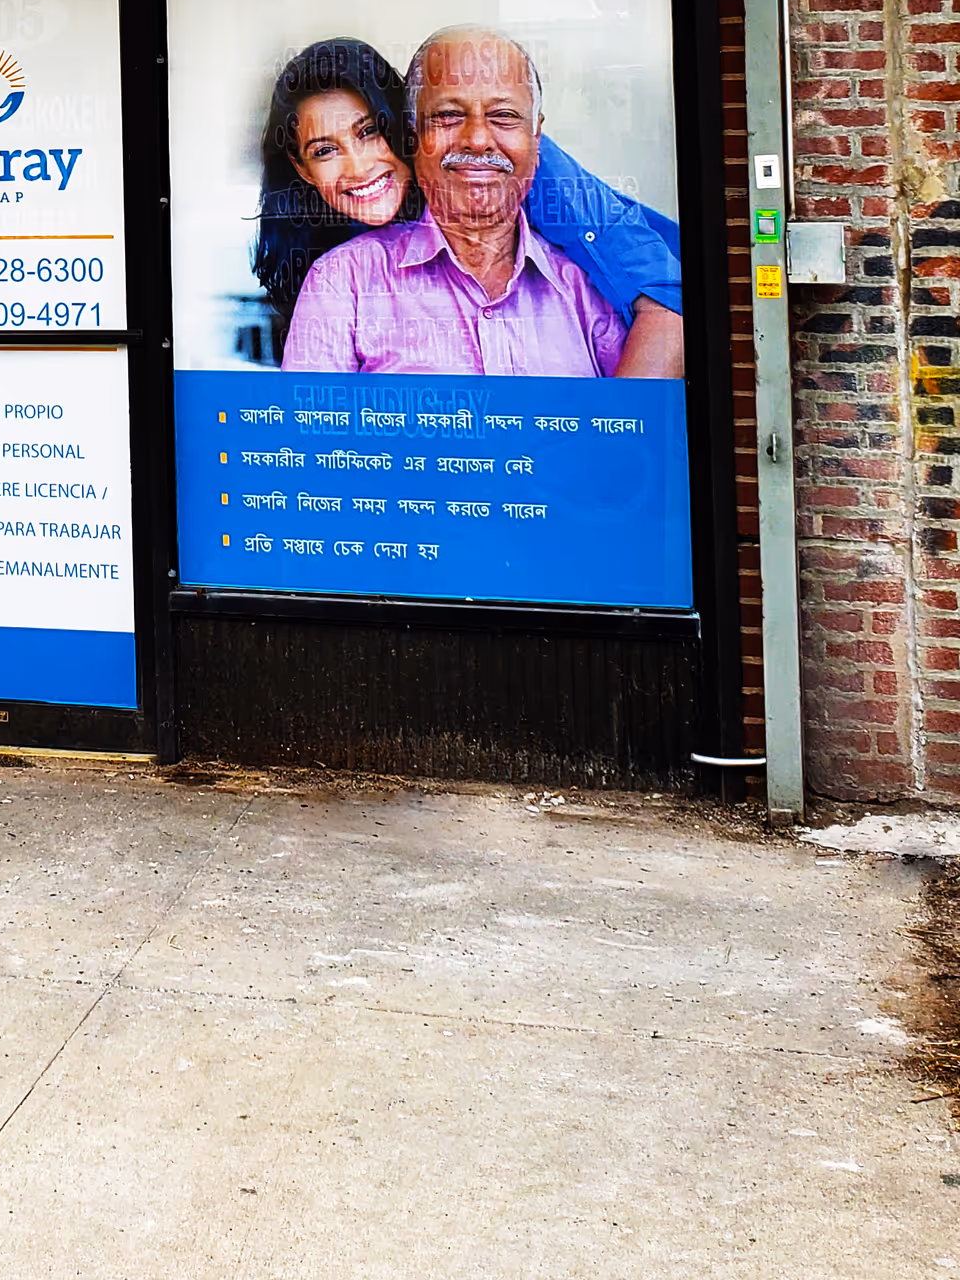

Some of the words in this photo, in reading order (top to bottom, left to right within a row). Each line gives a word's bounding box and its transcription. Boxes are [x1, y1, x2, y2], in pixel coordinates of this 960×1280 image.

[5, 404, 63, 419] PROPIO
[240, 406, 284, 424] আপনি
[294, 410, 351, 426] আপনার
[361, 408, 407, 427] নিজের
[417, 409, 473, 430] সহকারী
[484, 415, 524, 430] পছন্দ
[534, 416, 580, 432] করতে
[3, 443, 84, 459] PERSONAL
[241, 448, 306, 468] সহকারীর
[315, 450, 393, 470] সার্টিফিকেট
[403, 457, 426, 471] এর
[505, 455, 534, 474] নেই
[26, 483, 96, 499] LICENCIA
[102, 487, 107, 499] /
[242, 491, 287, 510] আপনি
[297, 492, 342, 512] নিজের
[397, 499, 436, 515] পছন্দ
[446, 501, 491, 517] করতে
[502, 503, 547, 519] পারেন
[39, 523, 121, 539] TRABAJAR
[244, 534, 273, 553] প্রতি
[282, 538, 324, 555] সপ্তাহে
[333, 541, 364, 556] চেক
